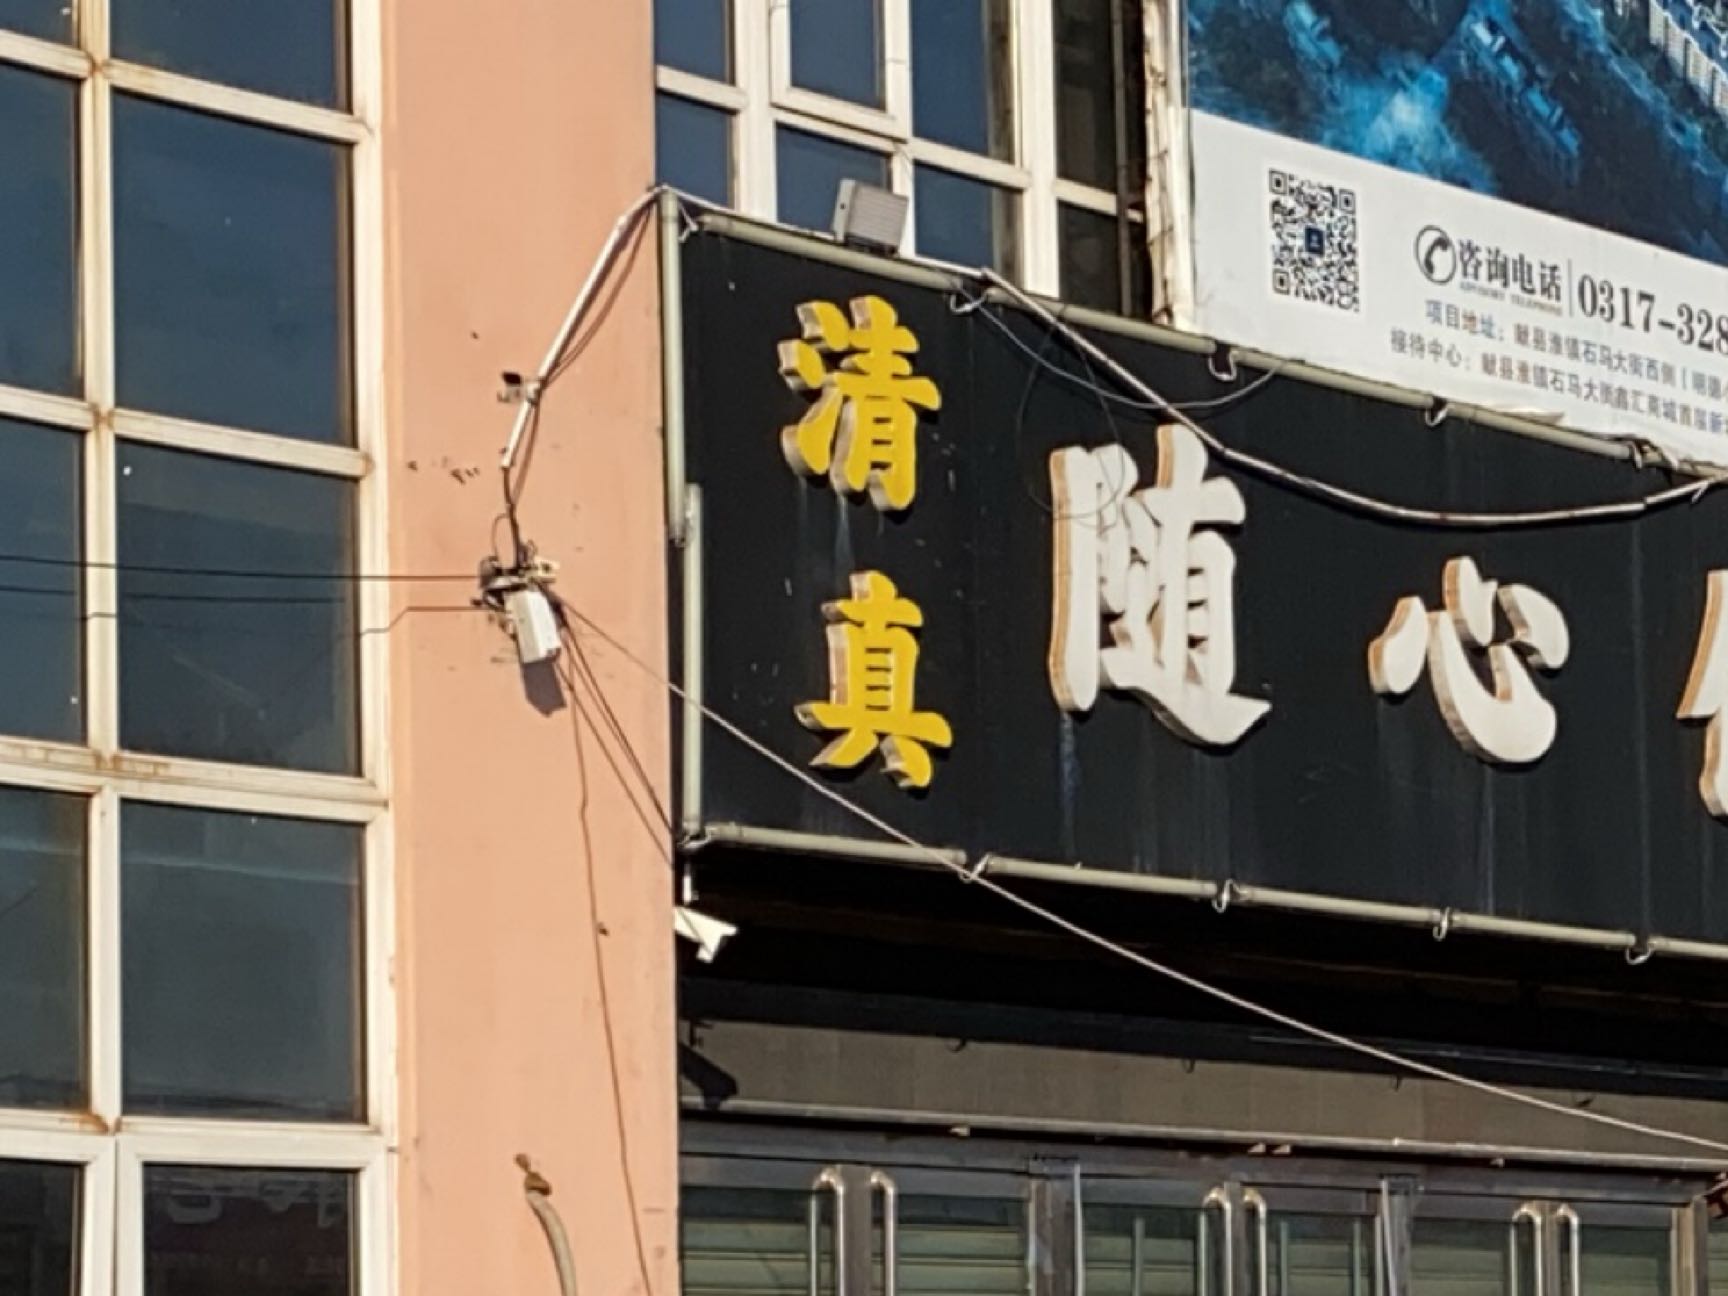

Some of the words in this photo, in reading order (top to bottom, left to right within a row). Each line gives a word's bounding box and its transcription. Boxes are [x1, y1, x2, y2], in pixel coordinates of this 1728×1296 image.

[1458, 239, 1562, 303] 咨询电话
[777, 295, 953, 790] 清真
